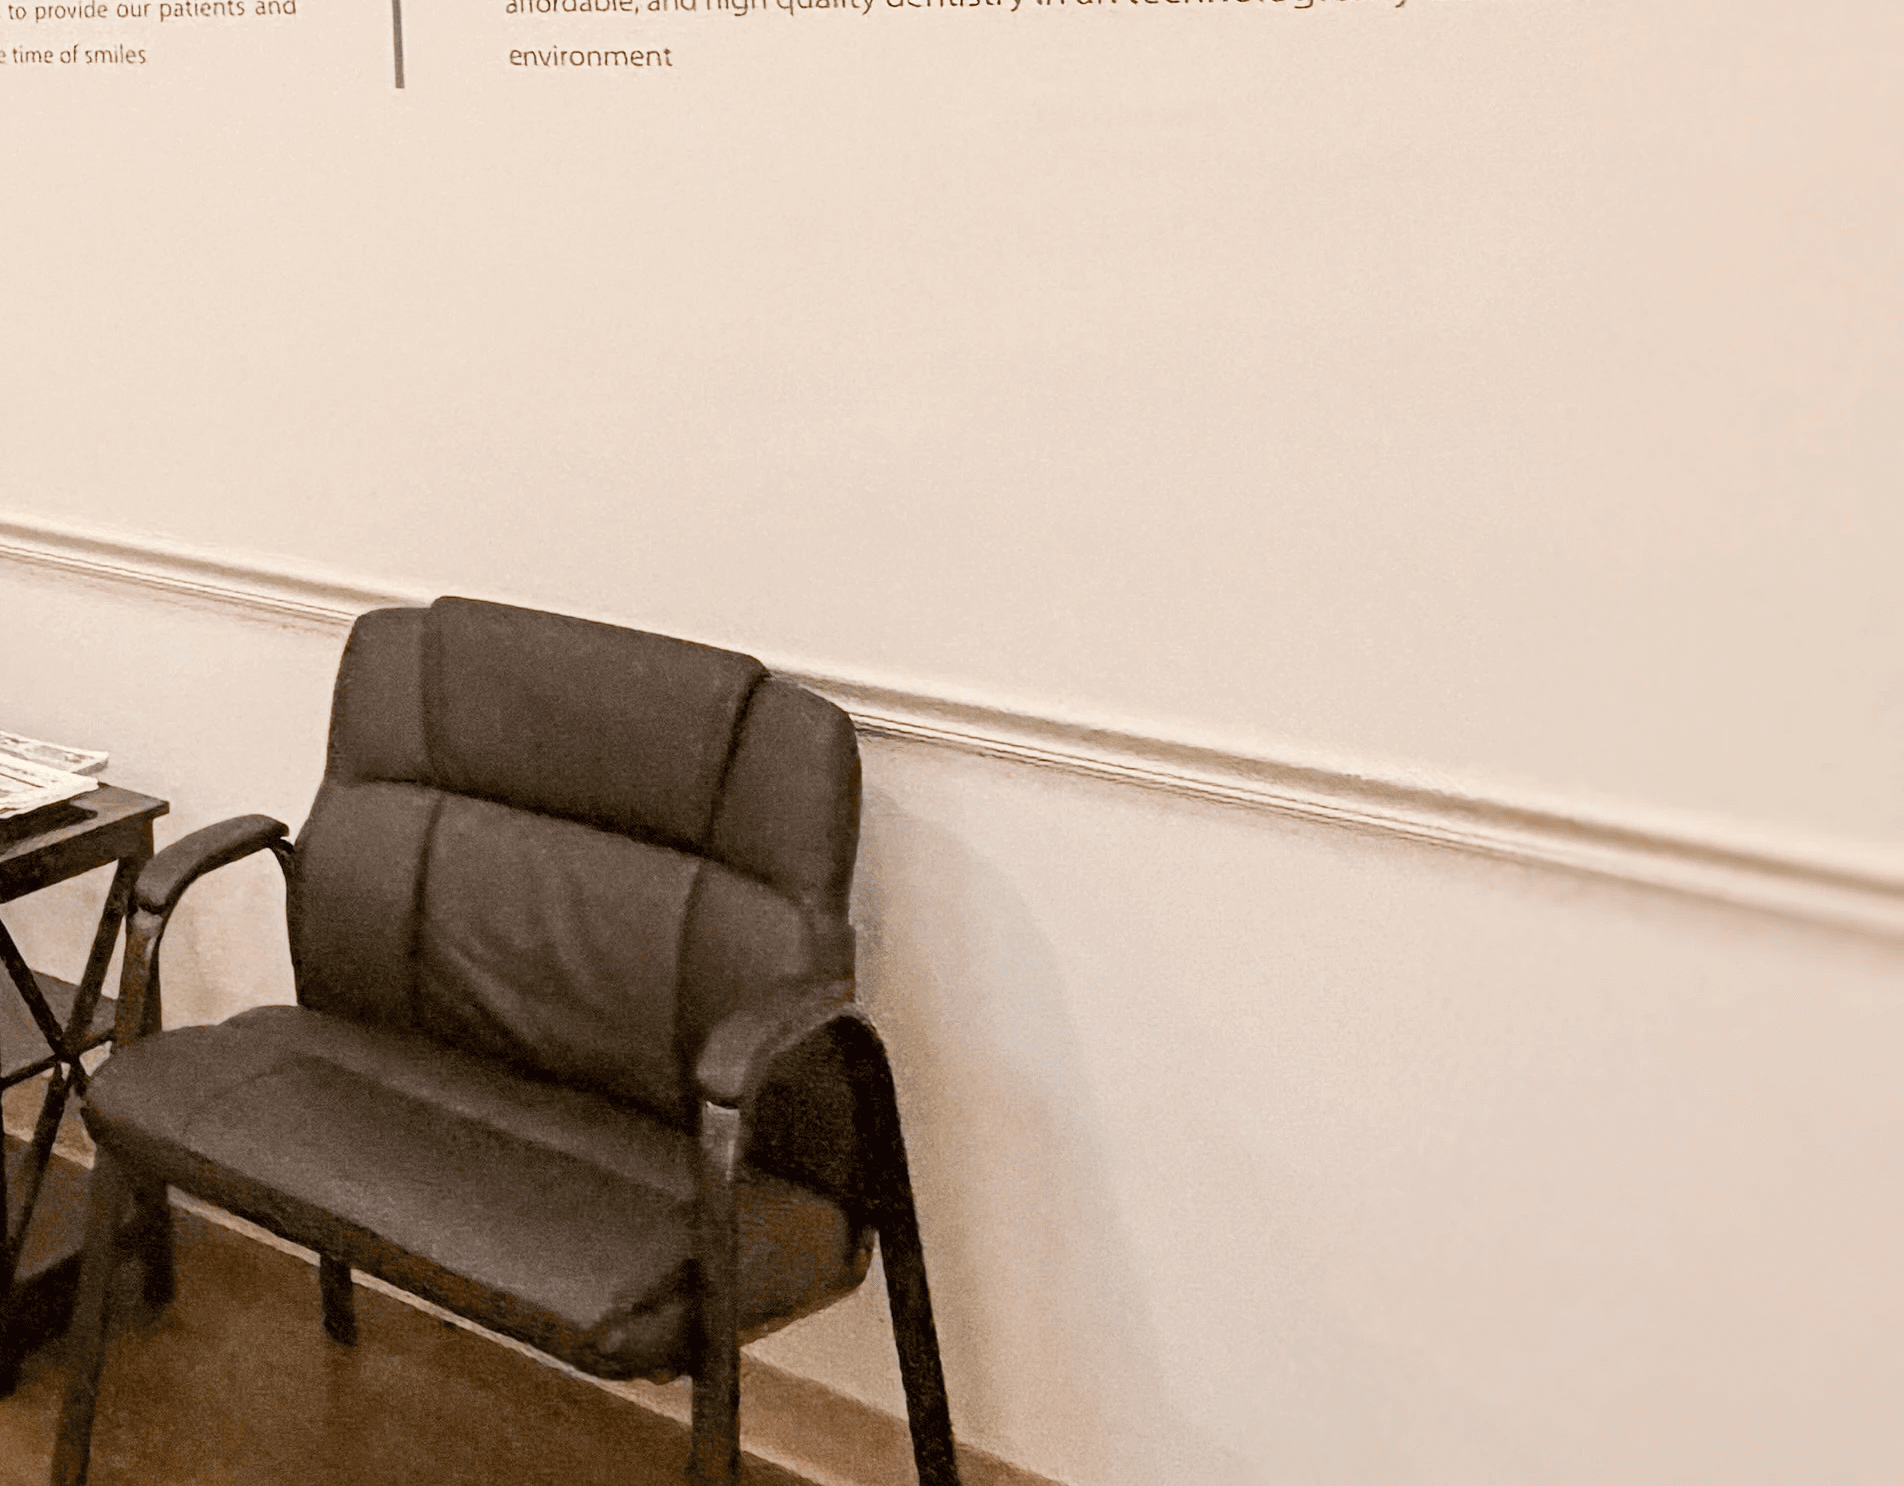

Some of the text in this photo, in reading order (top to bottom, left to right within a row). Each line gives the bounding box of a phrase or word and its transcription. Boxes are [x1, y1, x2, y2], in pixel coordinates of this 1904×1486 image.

[7, 4, 28, 21] to
[34, 0, 109, 24] provide
[116, 3, 151, 19] our
[159, 0, 246, 23] patients
[11, 44, 54, 65] time
[59, 43, 79, 64] of
[84, 43, 147, 65] smiles
[508, 43, 673, 68] environment
